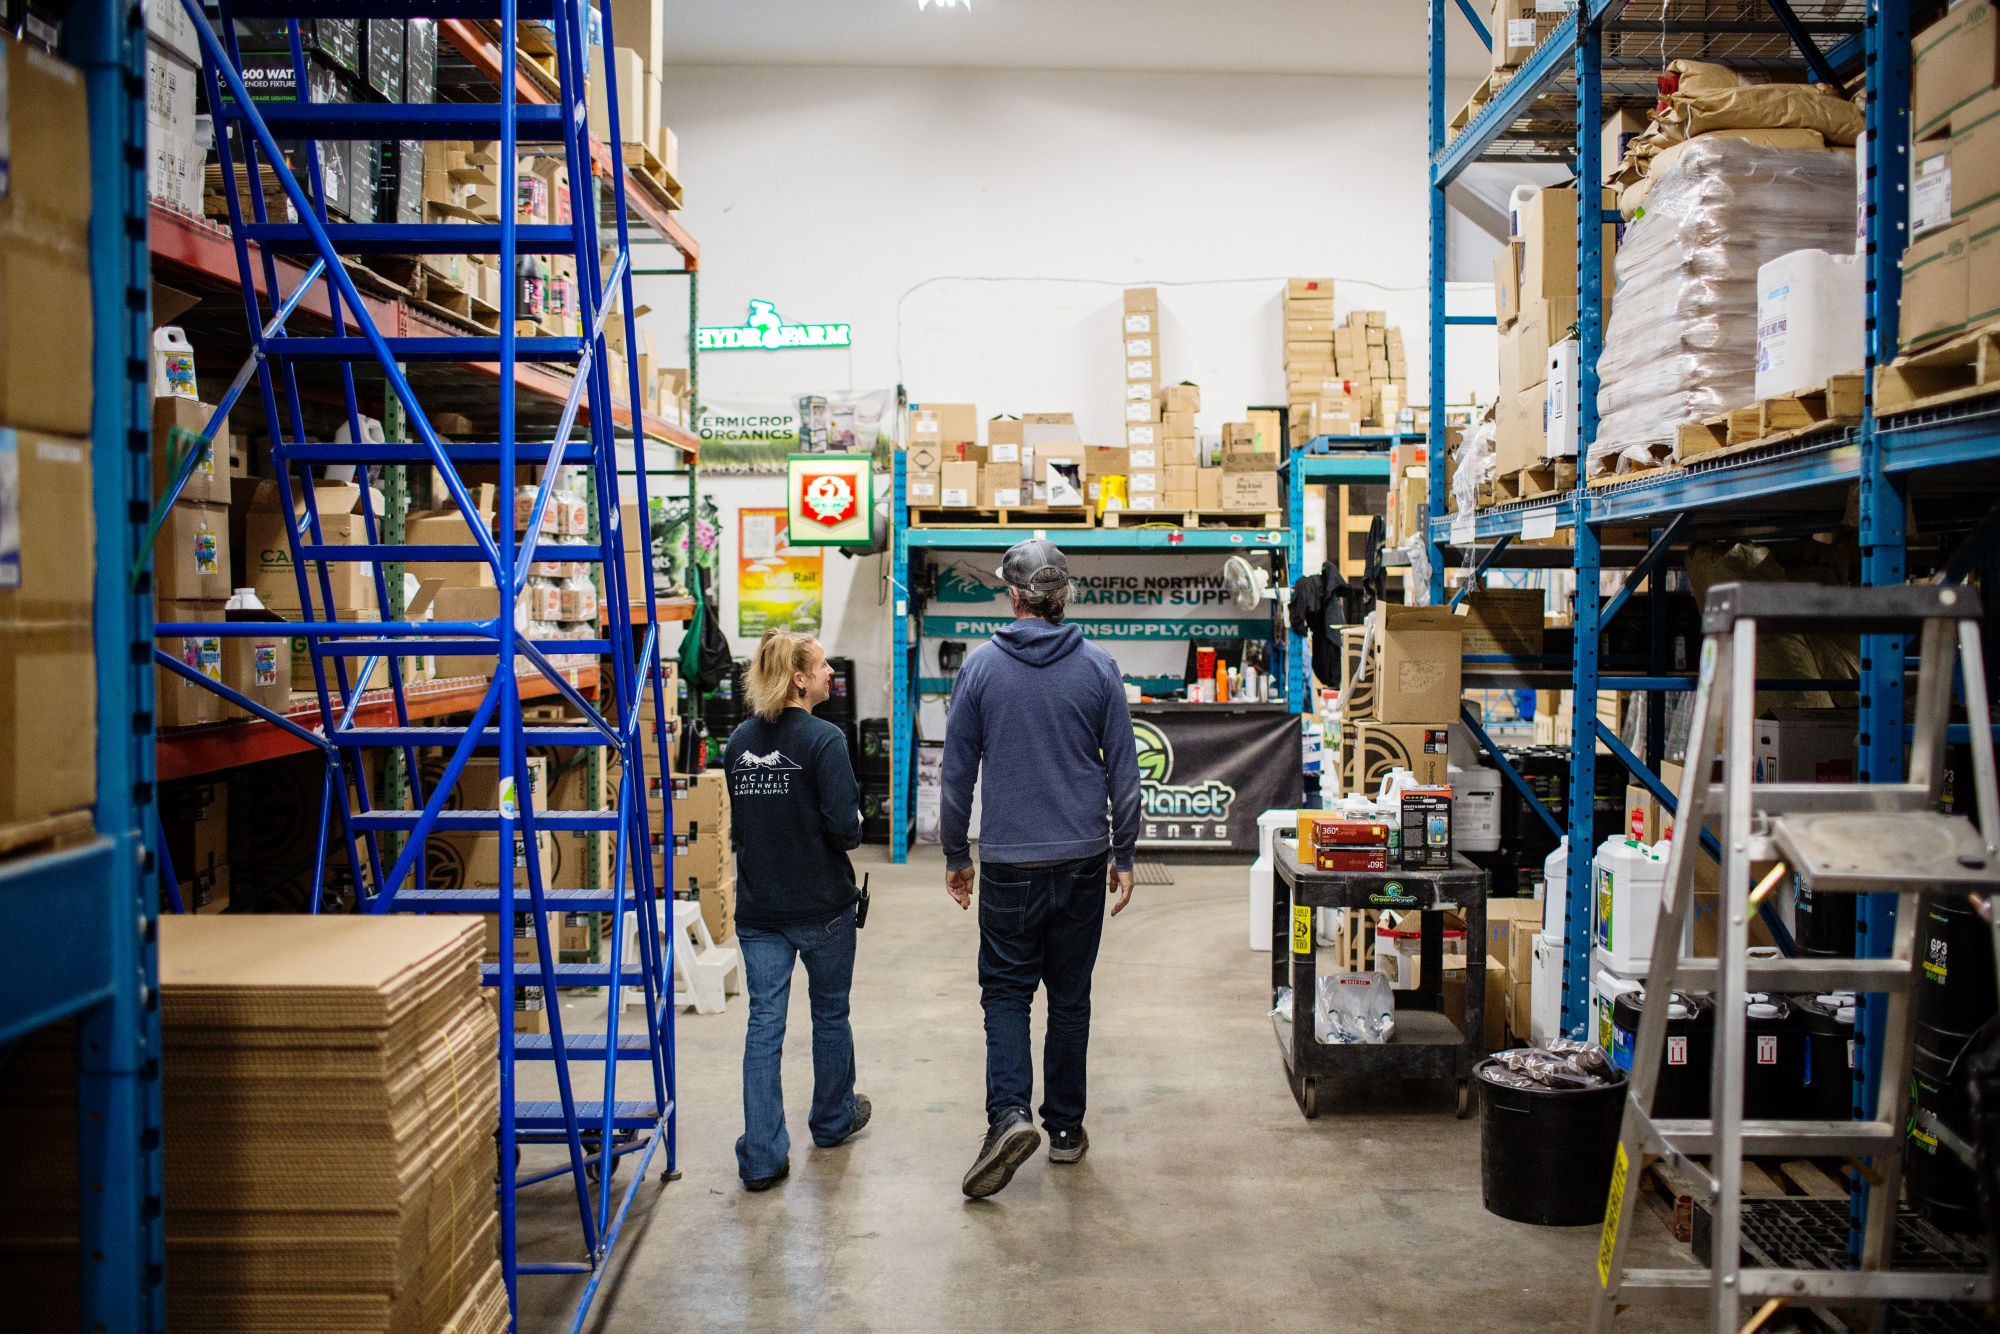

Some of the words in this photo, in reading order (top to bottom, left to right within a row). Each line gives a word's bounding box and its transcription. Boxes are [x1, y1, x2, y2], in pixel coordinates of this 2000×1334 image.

[266, 69, 296, 79] WAT
[244, 80, 268, 88] ENDED
[270, 80, 296, 88] FIXTURE
[703, 416, 793, 428] ERMICROP
[700, 428, 793, 440] ORGANICS
[1144, 576, 1224, 589] NORTHW
[1169, 590, 1232, 605] SUPP
[1141, 786, 1230, 815] Planet
[1930, 938, 1948, 955] GP3
